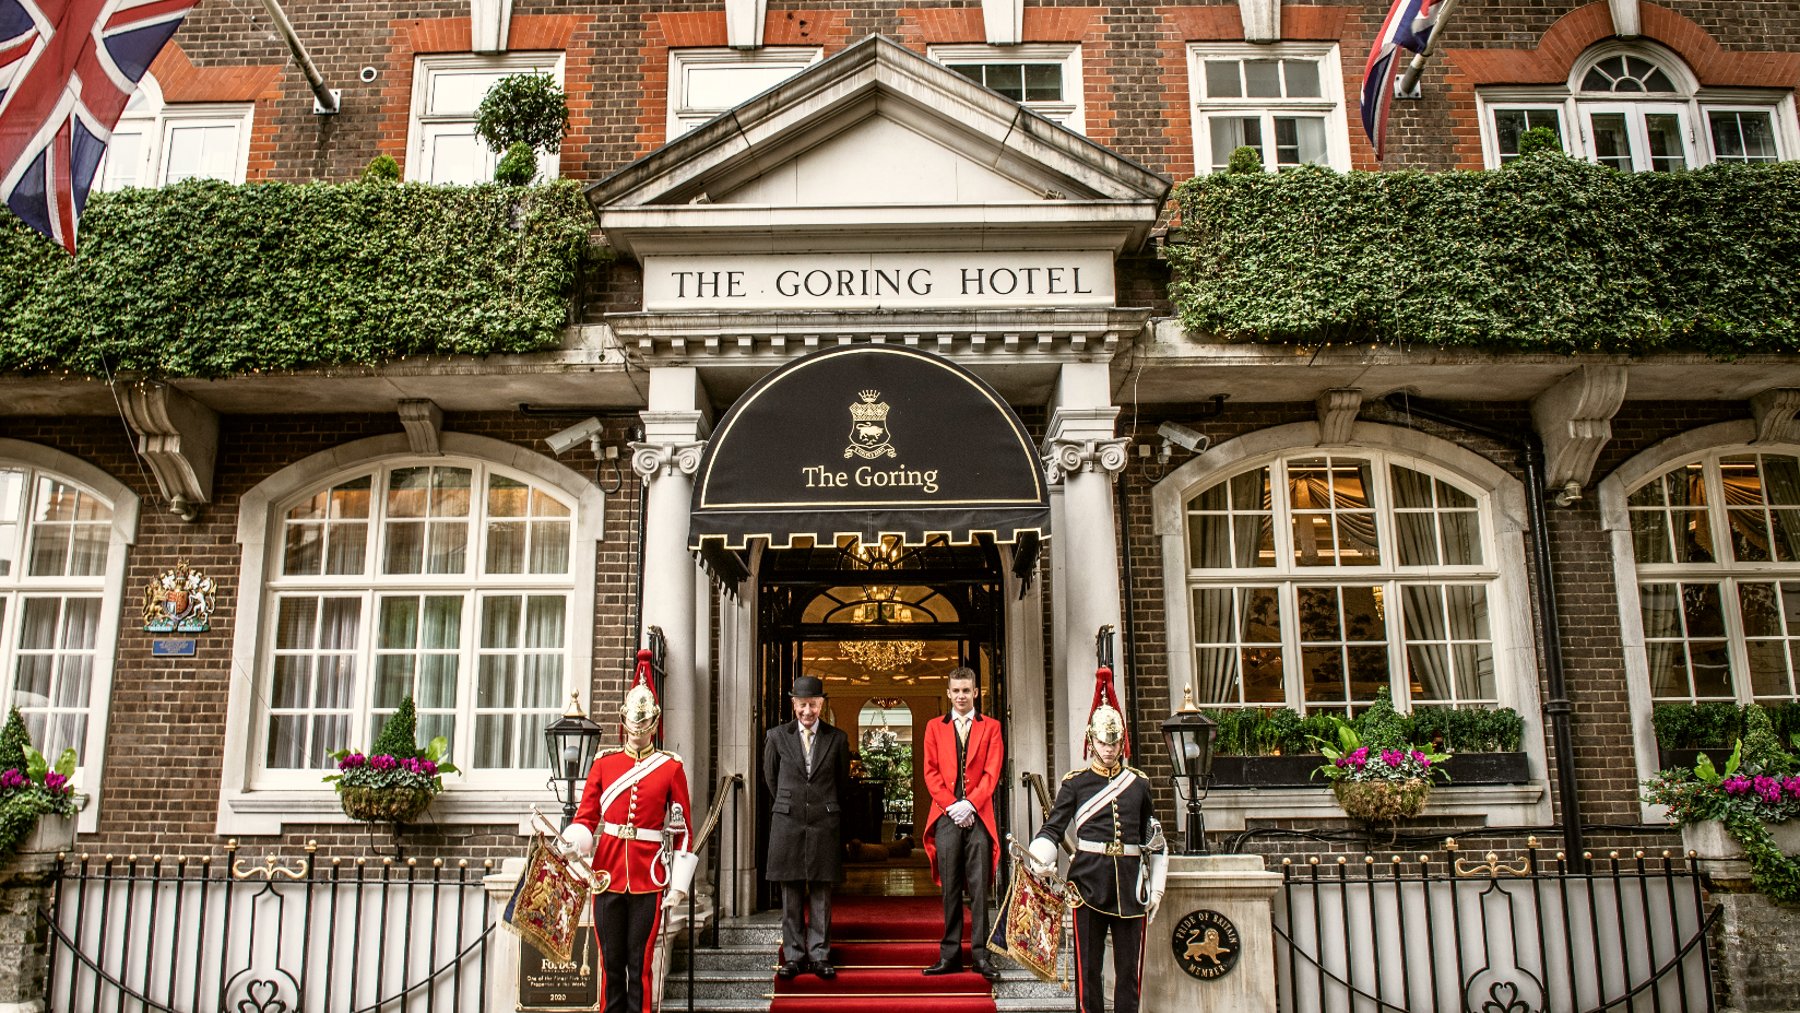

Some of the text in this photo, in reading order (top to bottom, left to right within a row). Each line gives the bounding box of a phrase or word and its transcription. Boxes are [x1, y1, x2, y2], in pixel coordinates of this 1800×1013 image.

[671, 267, 1092, 298] THE GORING HOTEL
[802, 464, 939, 493] The Goring
[1176, 912, 1237, 944] PRIDE OF BRITAIN
[1189, 964, 1225, 977] MEMBER
